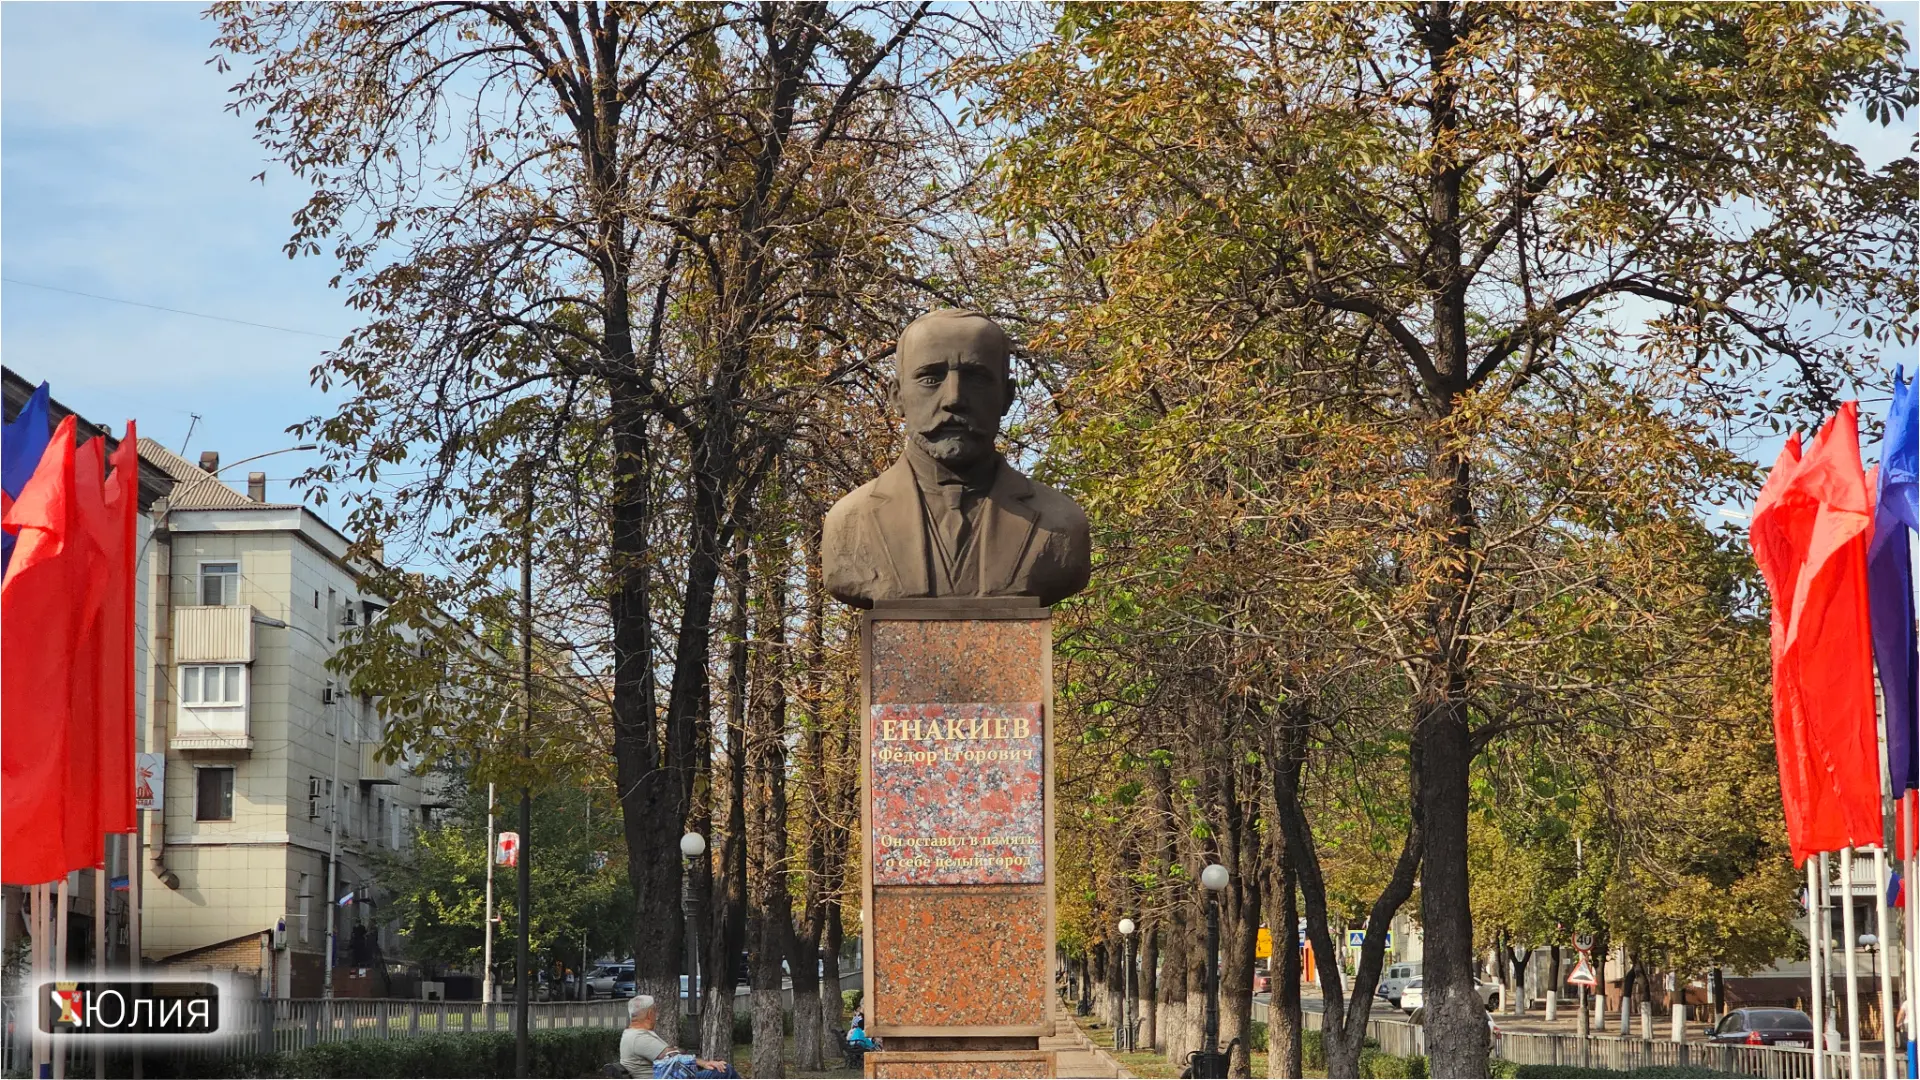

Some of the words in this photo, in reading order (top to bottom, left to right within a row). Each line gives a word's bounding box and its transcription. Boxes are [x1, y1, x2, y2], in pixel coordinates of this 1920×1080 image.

[882, 718, 1030, 741] ЕНАКИЕВ
[878, 747, 937, 765] Фёдор
[944, 747, 1033, 764] Егорович
[881, 835, 902, 847] Он
[907, 836, 966, 847] оставил
[970, 836, 978, 846] в
[982, 835, 1035, 846] память
[886, 859, 895, 868] о
[898, 855, 931, 868] себе
[936, 856, 987, 869] целый
[989, 856, 1032, 870] город
[1577, 934, 1591, 945] 40
